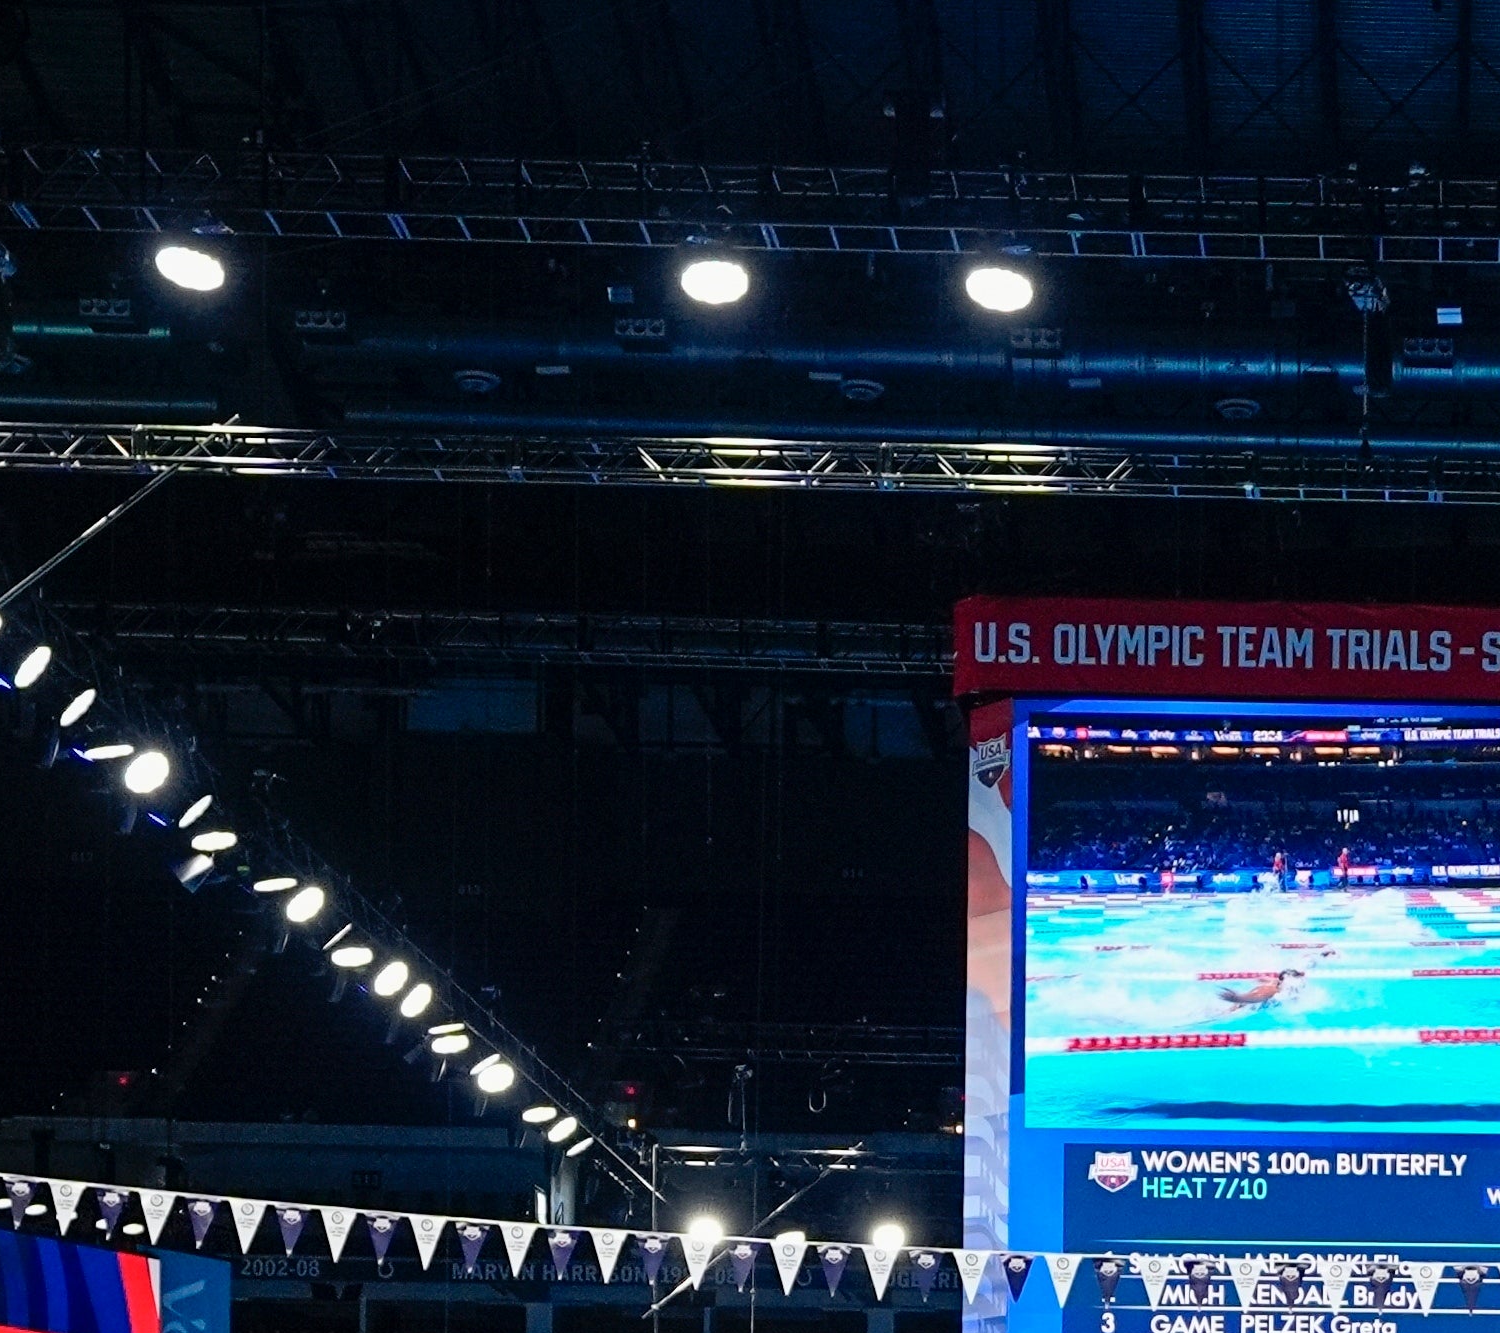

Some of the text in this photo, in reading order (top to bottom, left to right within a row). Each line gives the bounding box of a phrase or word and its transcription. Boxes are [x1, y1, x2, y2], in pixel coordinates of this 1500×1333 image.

[974, 621, 1041, 665] U.S.
[1053, 623, 1206, 668] OLYMPIC
[1217, 626, 1315, 670] TEAM
[1326, 628, 1452, 672] TRIALS
[980, 743, 1002, 763] USA
[1141, 1150, 1468, 1178] WOMEN'S 100m BUTTERFLY
[1141, 1177, 1268, 1201] HEAT 7/10
